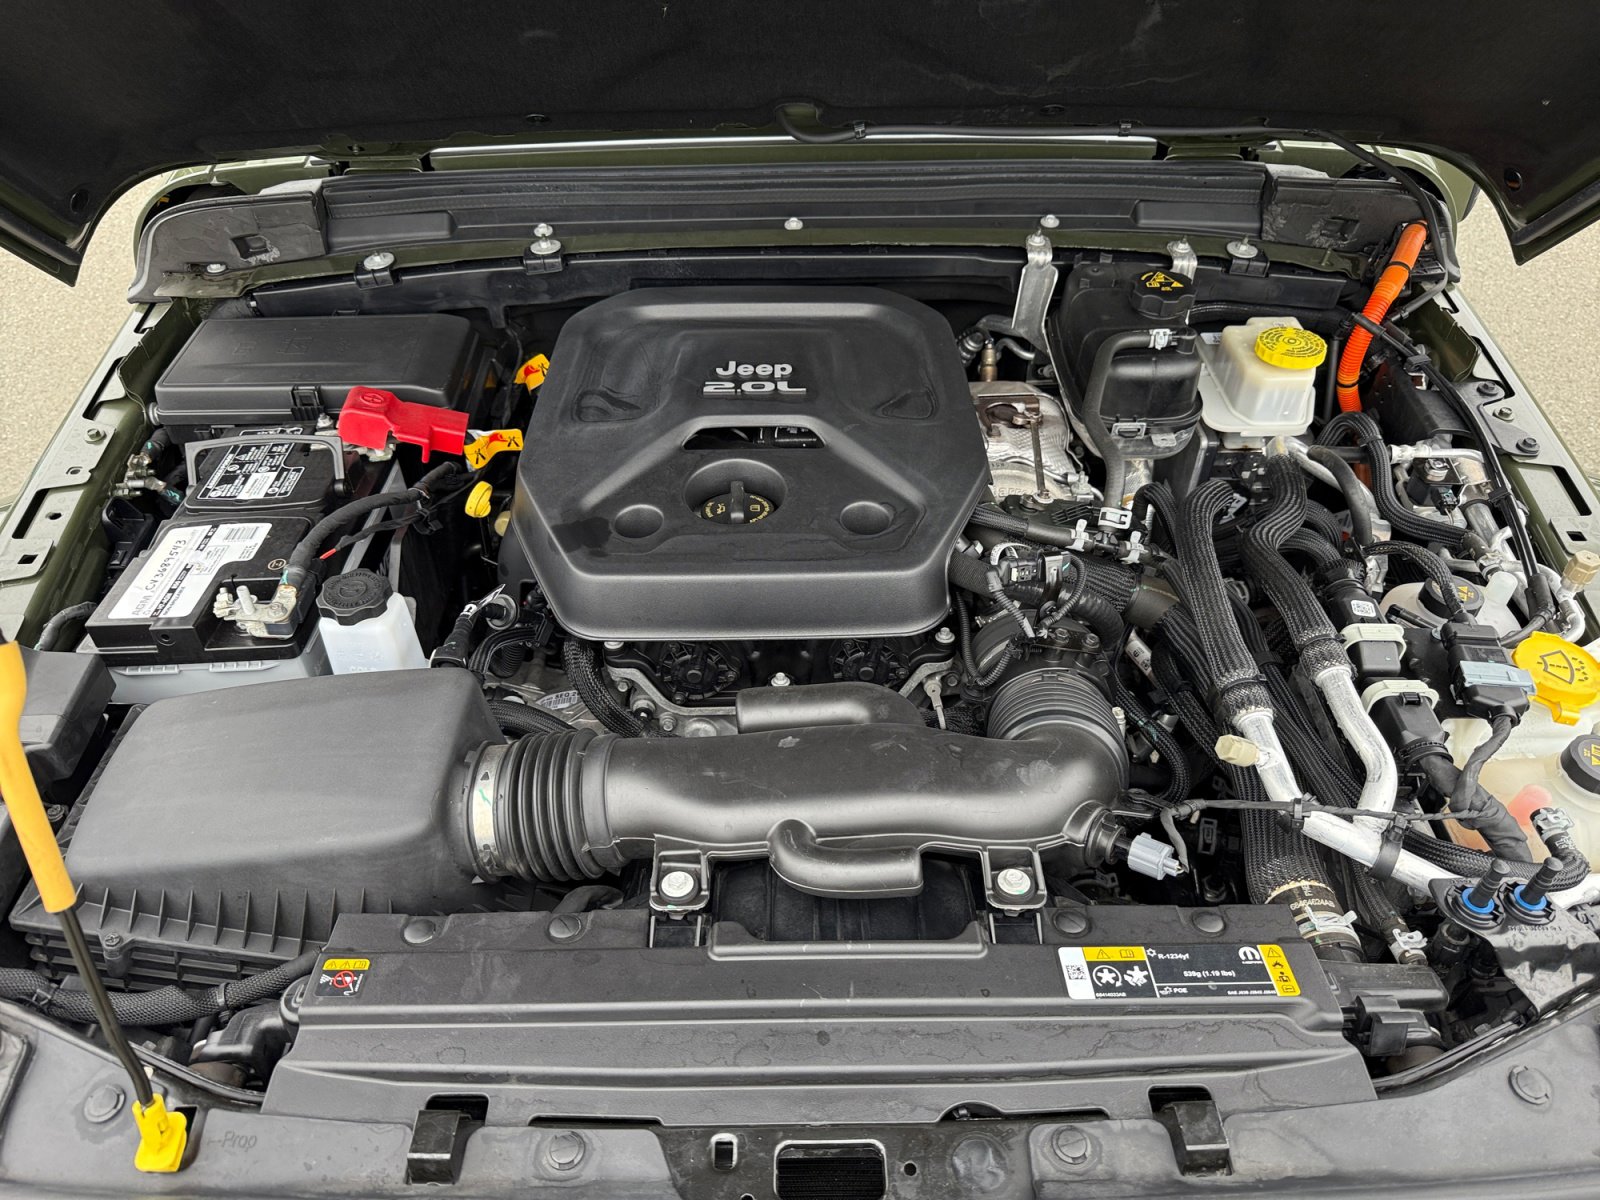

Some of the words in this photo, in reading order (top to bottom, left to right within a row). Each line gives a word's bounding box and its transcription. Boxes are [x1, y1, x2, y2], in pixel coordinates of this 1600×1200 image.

[715, 360, 793, 379] Jeep
[703, 381, 806, 394] 2.0L
[1183, 970, 1201, 978] 539g
[1202, 970, 1220, 978] (1.19
[1221, 970, 1236, 978] lbs)
[221, 1130, 258, 1153] Prop
